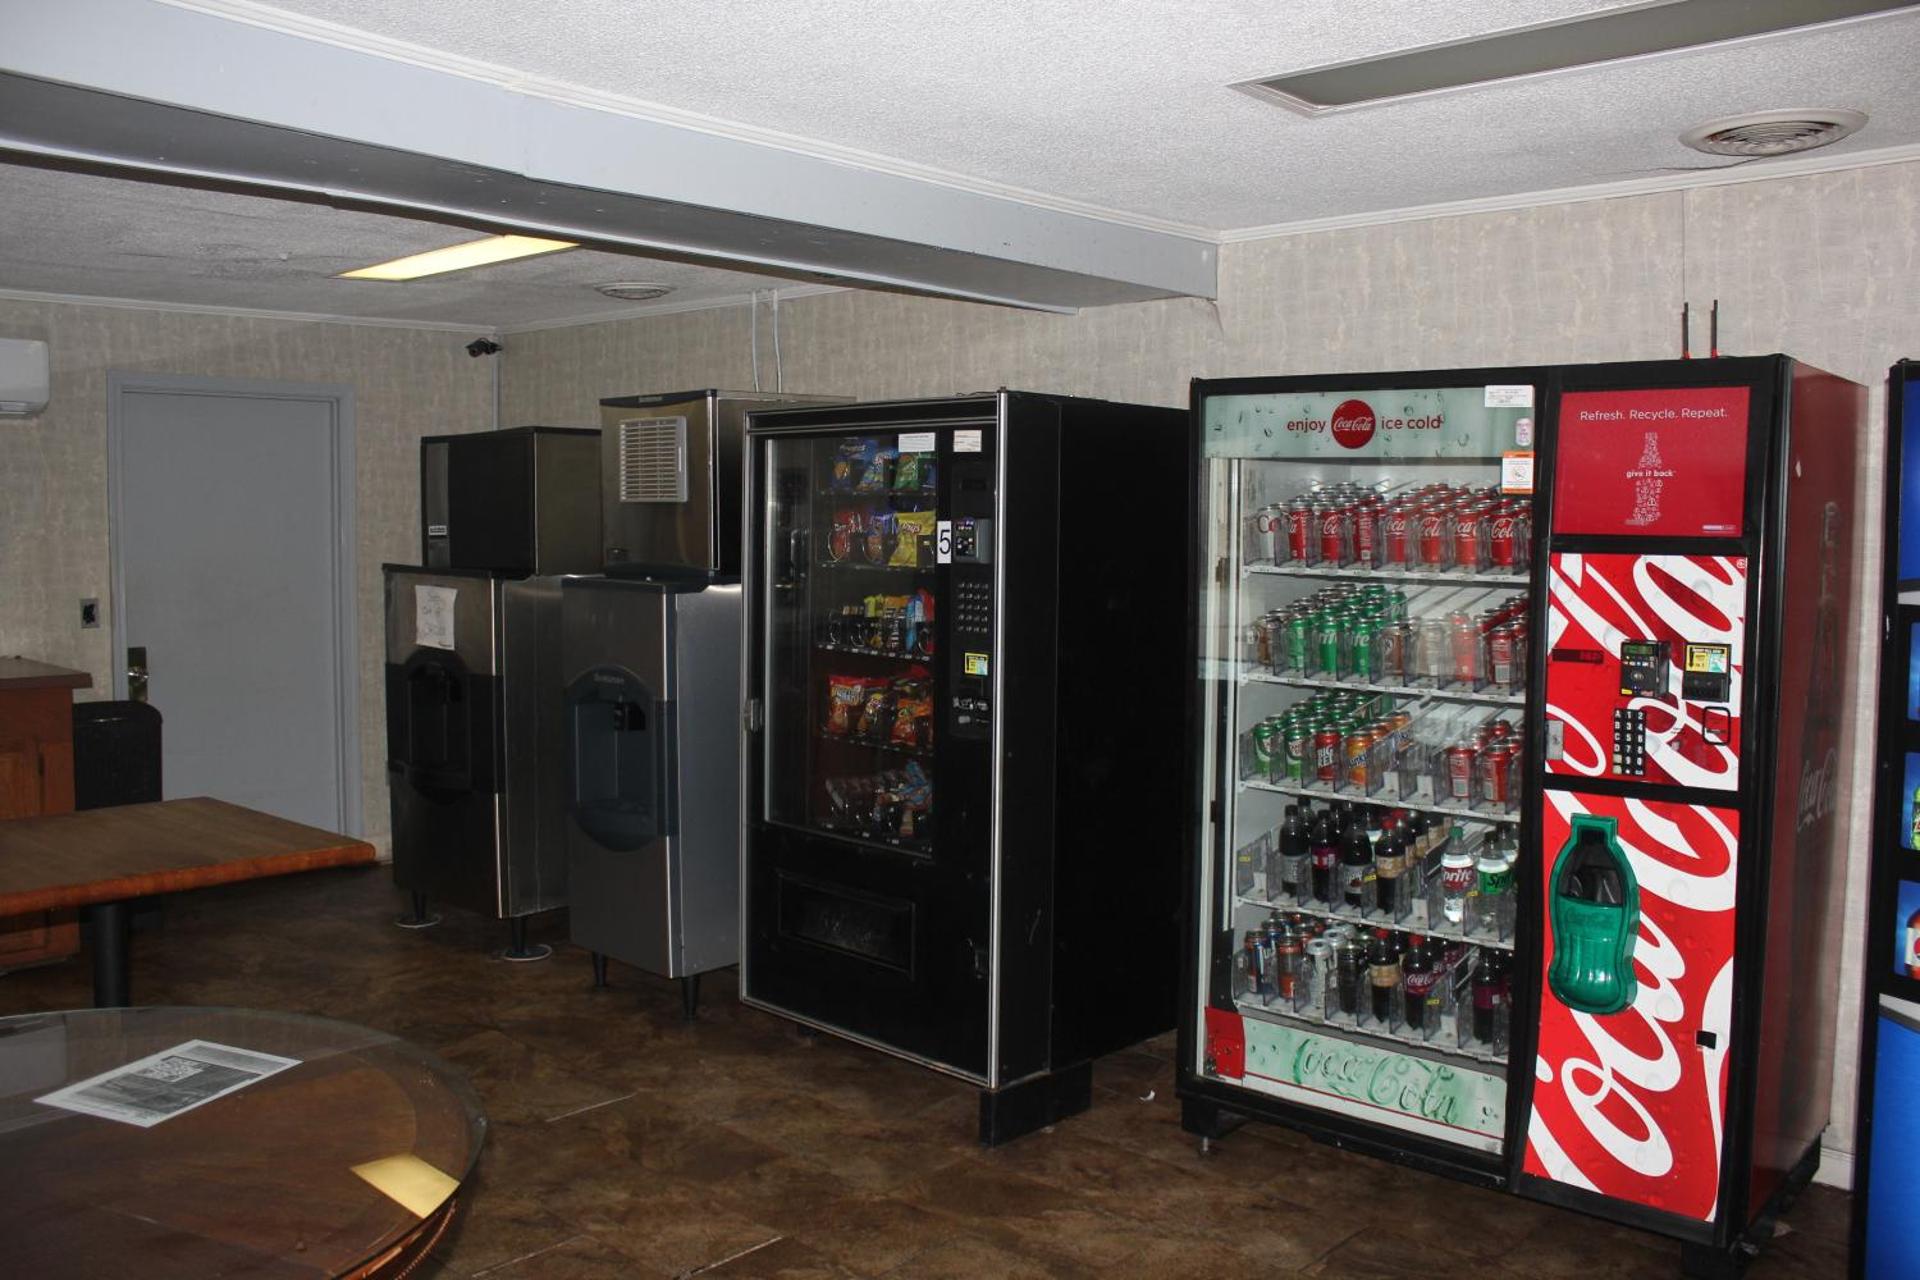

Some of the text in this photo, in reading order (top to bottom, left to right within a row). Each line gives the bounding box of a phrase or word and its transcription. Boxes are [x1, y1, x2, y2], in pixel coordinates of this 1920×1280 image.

[1381, 413, 1442, 431] ice cold
[1580, 406, 1728, 421] Refresh. Recycle. Repeat.
[1287, 416, 1326, 434] enjoy
[939, 529, 951, 555] 5
[1637, 711, 1644, 720] 2
